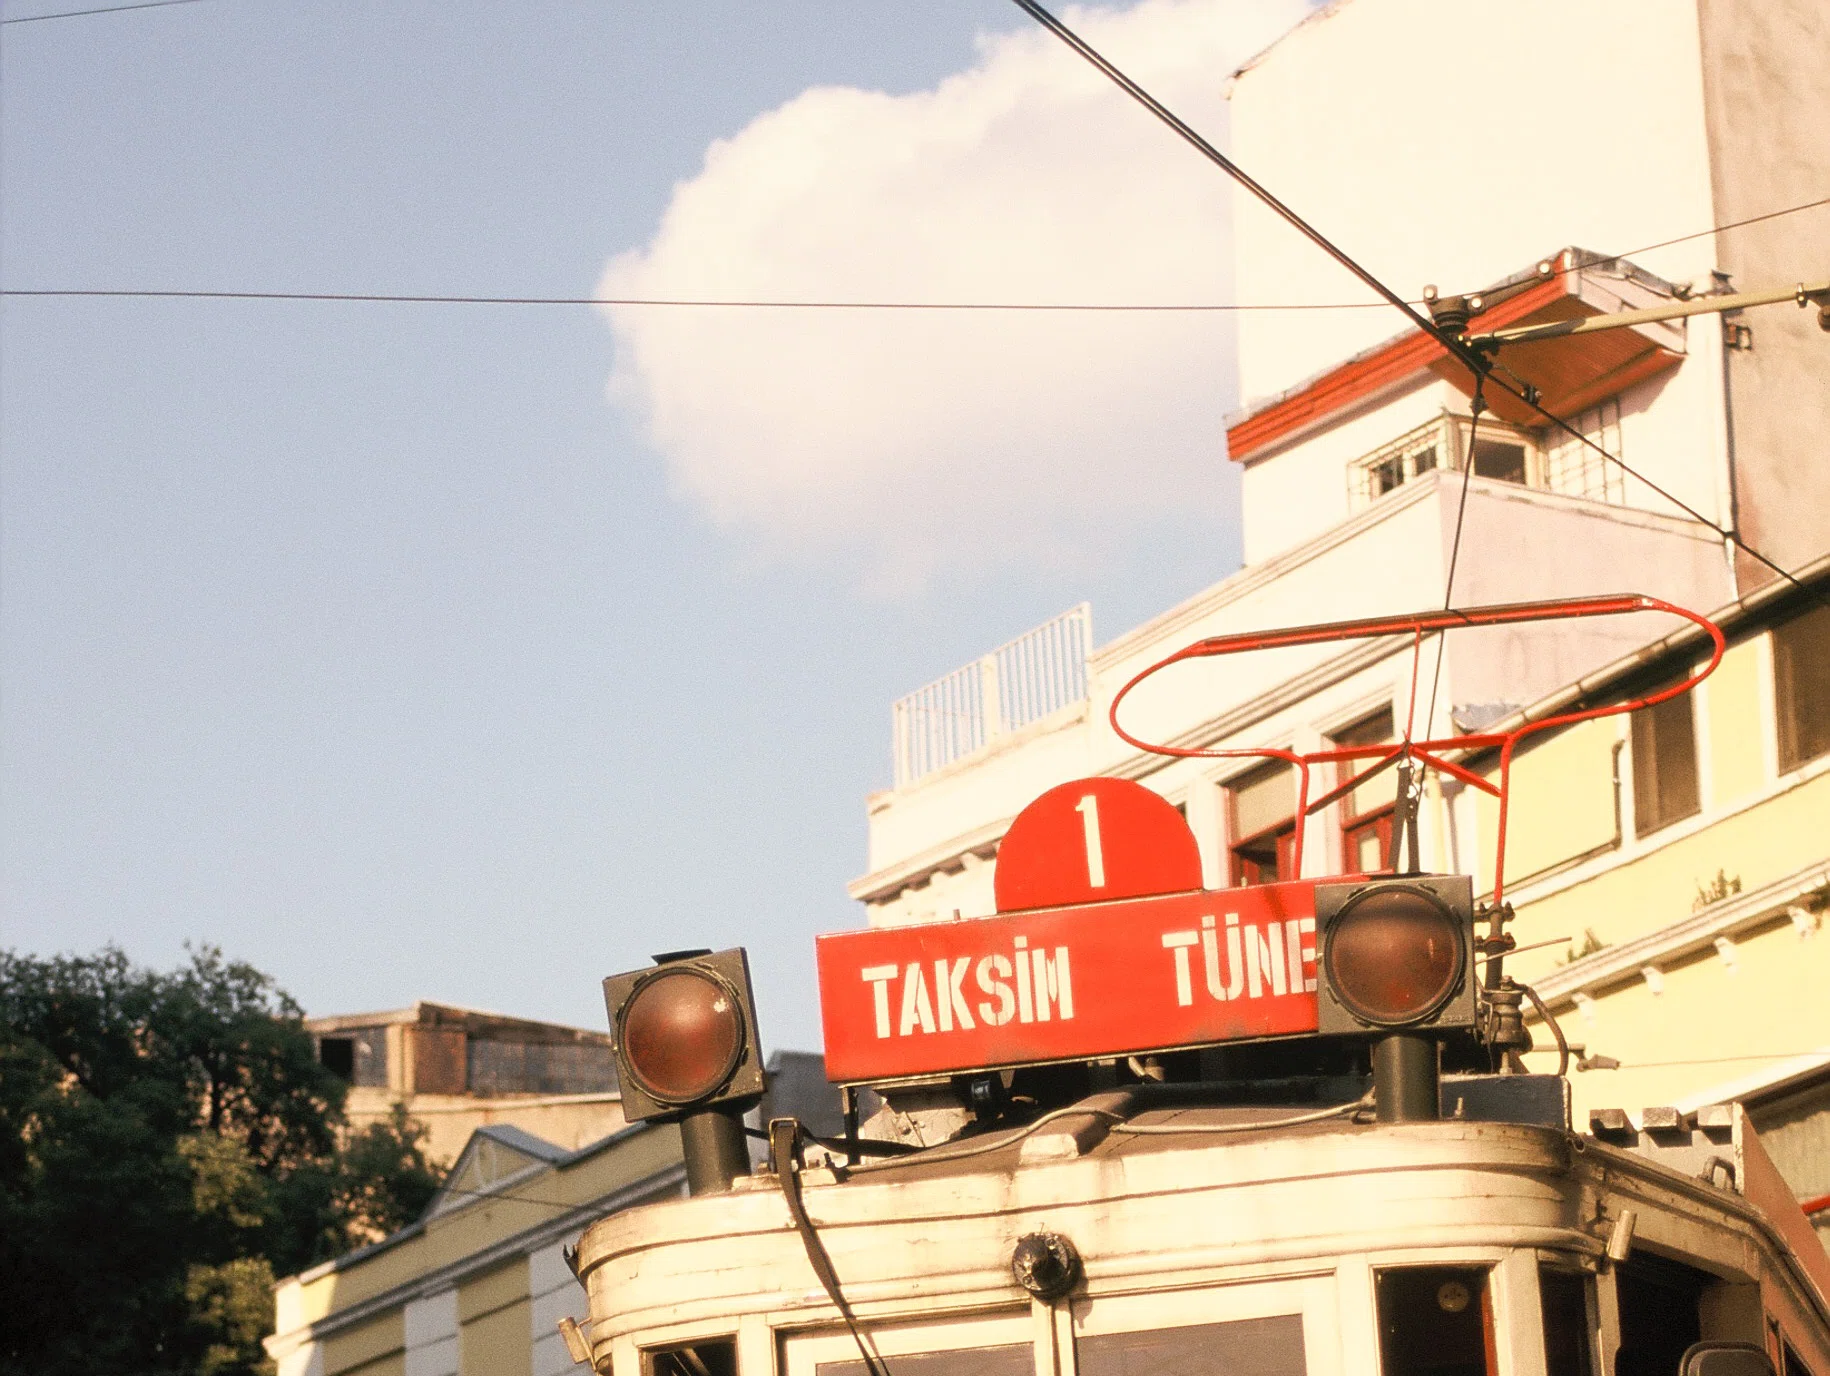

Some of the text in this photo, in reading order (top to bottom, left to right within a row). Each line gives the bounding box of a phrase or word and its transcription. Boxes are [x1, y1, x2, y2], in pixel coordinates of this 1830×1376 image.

[1075, 795, 1105, 888] 1
[861, 913, 1317, 1039] TAKSİM TÜNE
